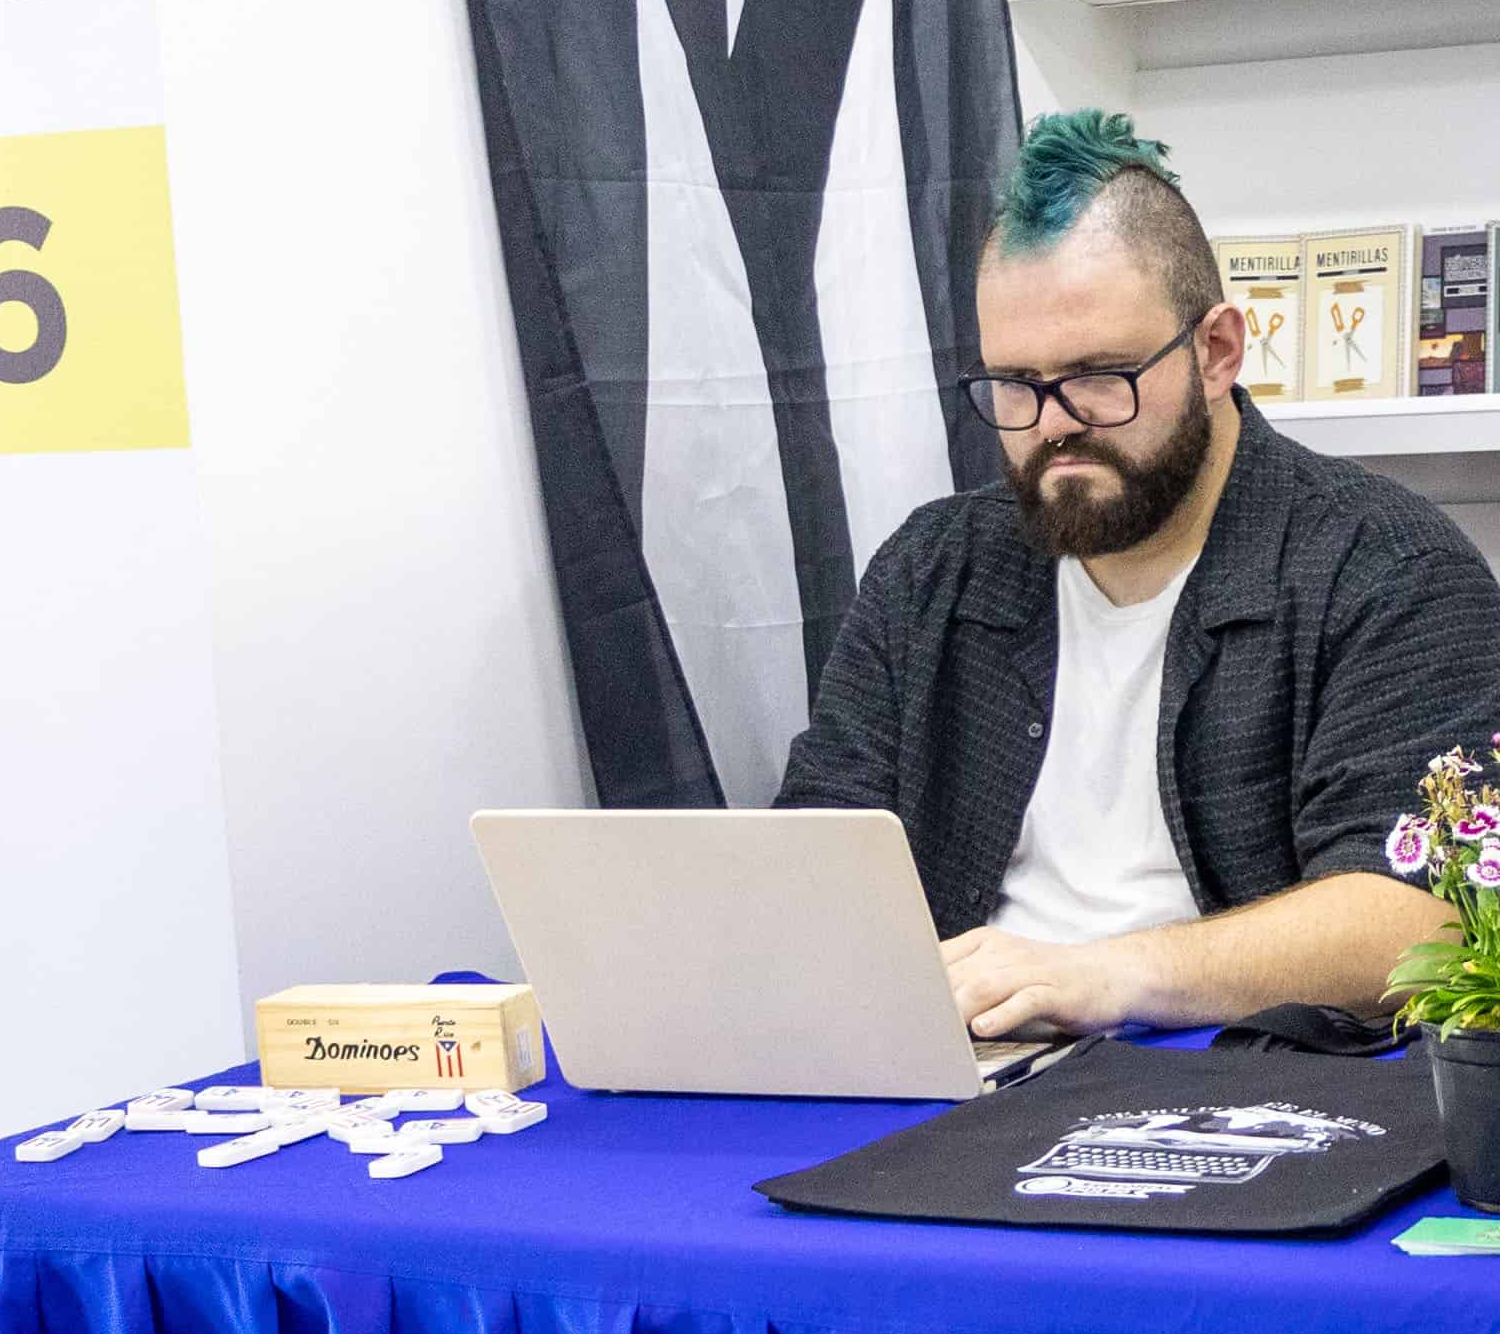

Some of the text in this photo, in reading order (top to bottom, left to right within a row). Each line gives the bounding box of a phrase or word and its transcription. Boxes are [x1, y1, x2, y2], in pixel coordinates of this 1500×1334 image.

[1316, 247, 1389, 268] MENTIRILLAS
[431, 1015, 457, 1027] Puerto
[434, 1027, 455, 1038] Rico
[304, 1036, 421, 1062] Dominoes
